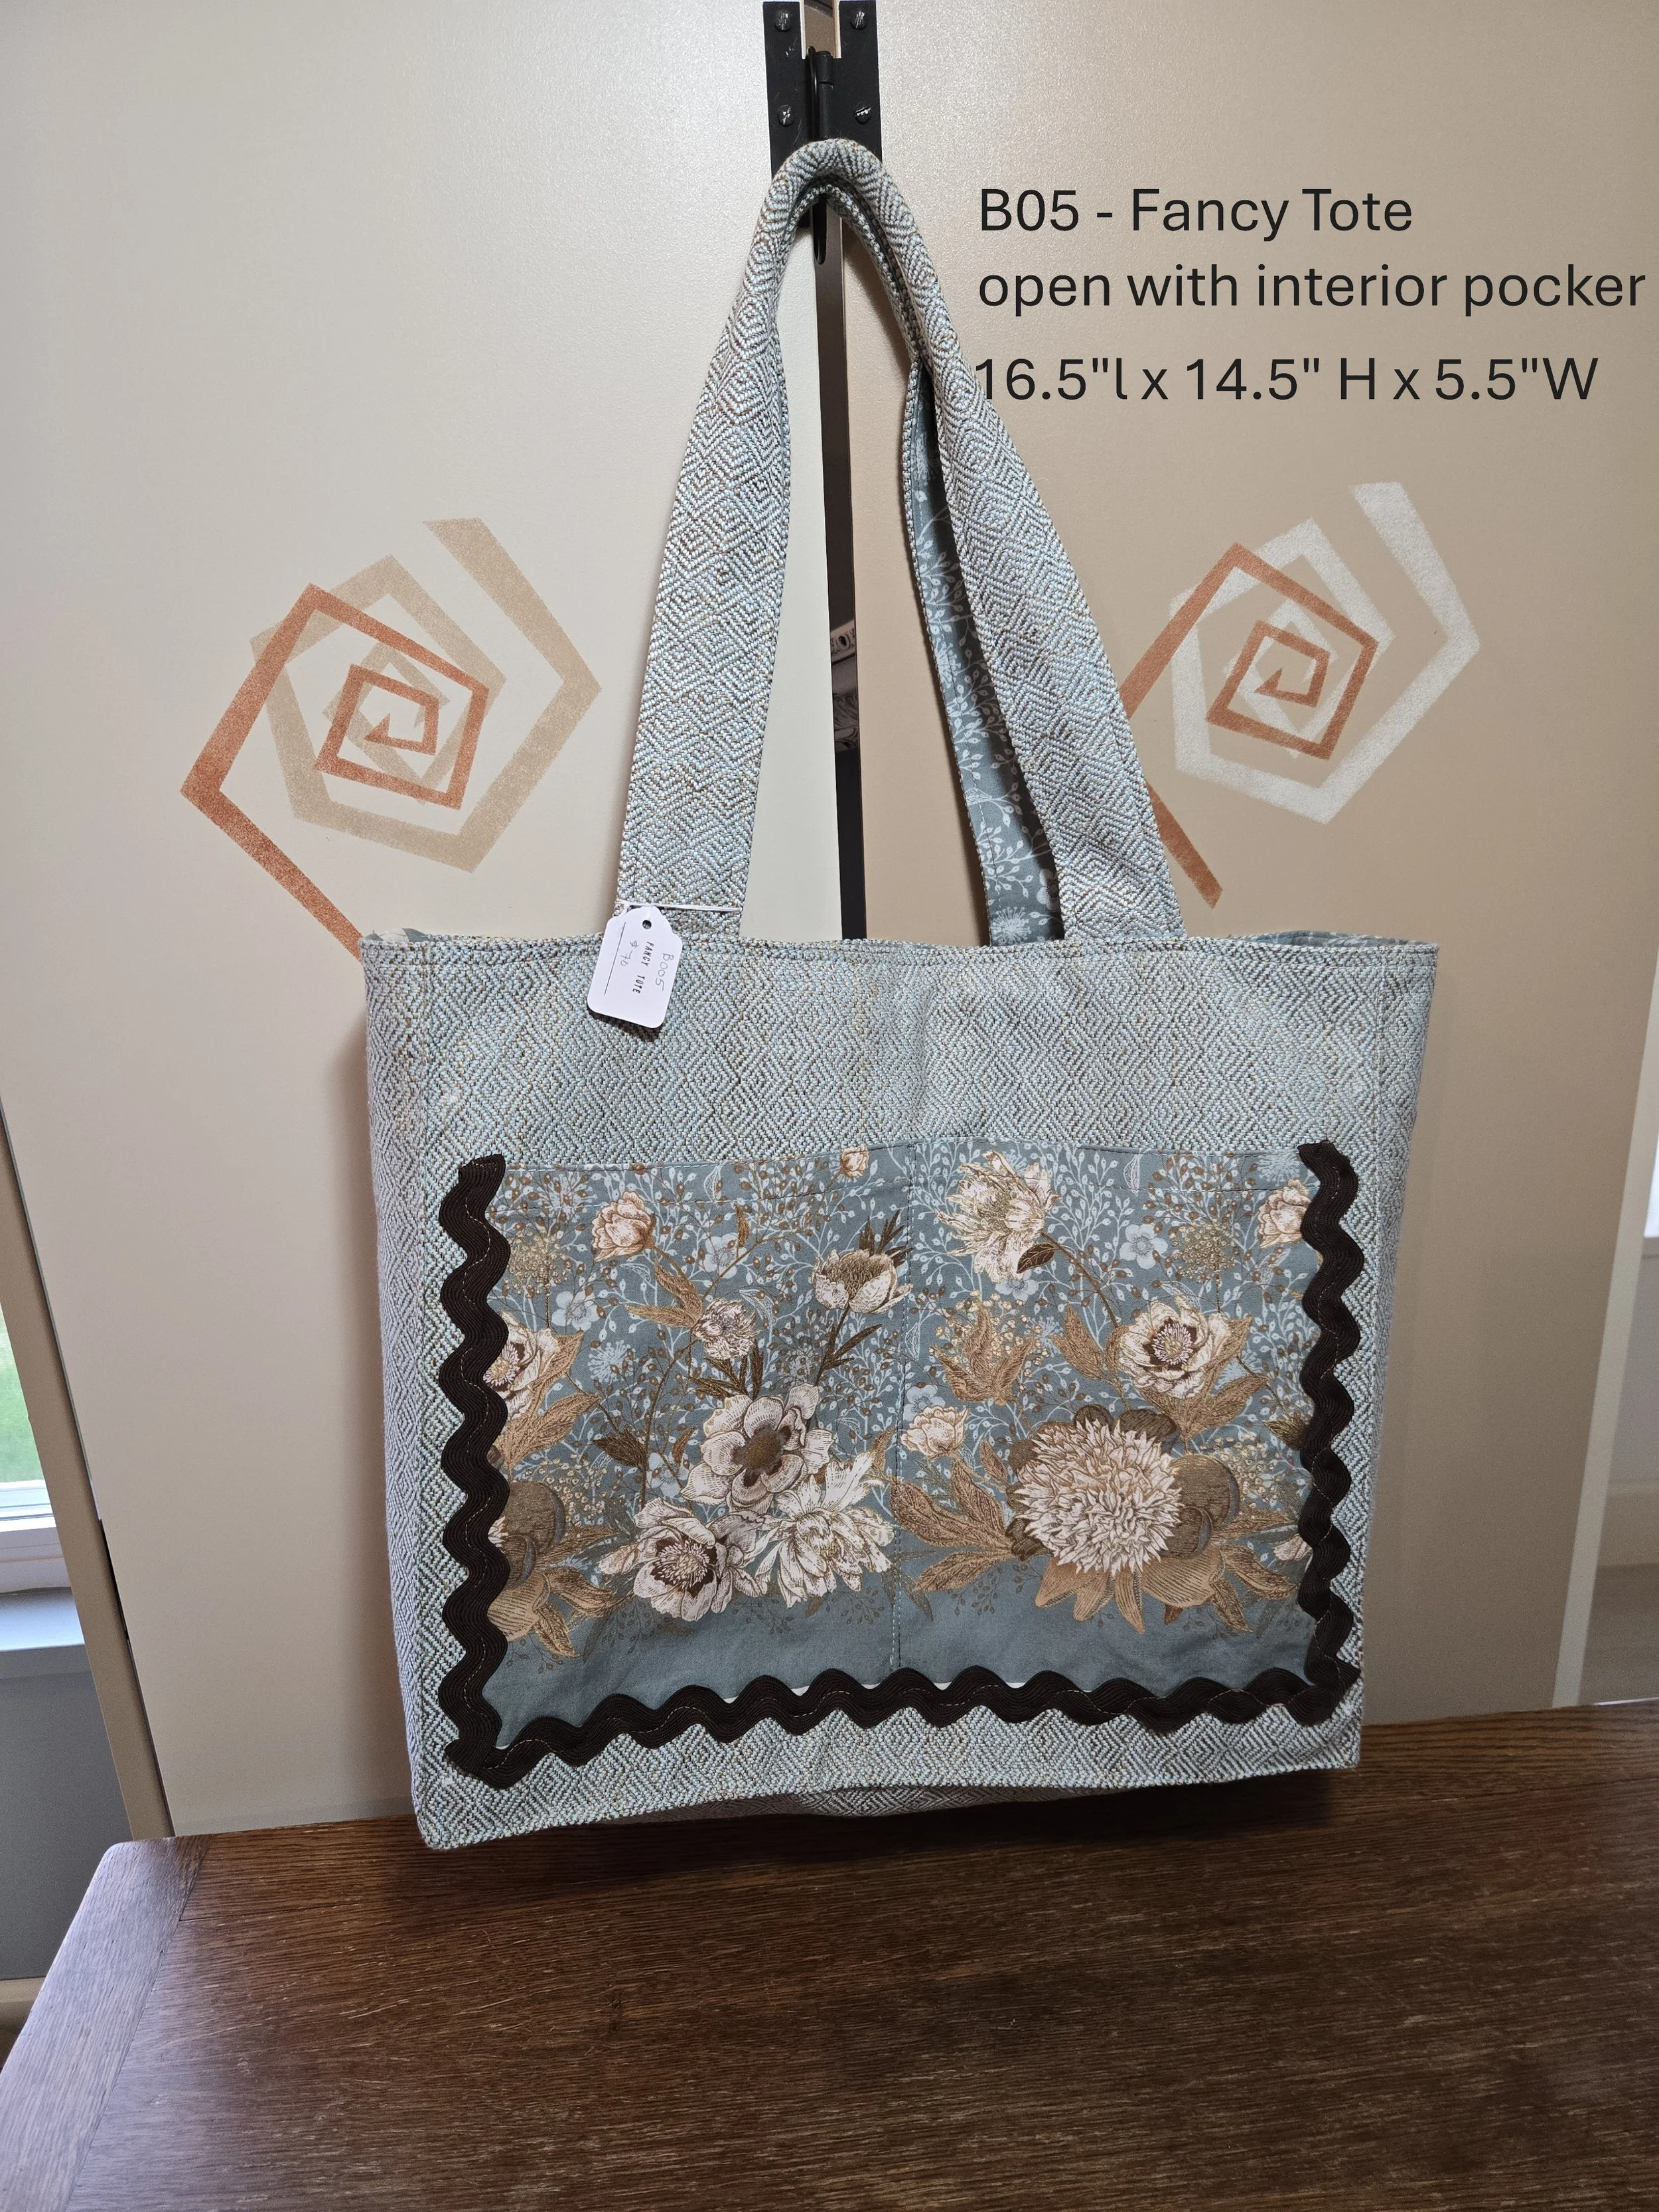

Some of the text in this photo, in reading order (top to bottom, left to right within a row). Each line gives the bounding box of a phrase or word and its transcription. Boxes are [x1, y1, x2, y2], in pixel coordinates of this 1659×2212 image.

[632, 940, 654, 994] FANCY TOTE
[655, 952, 675, 992] B005
